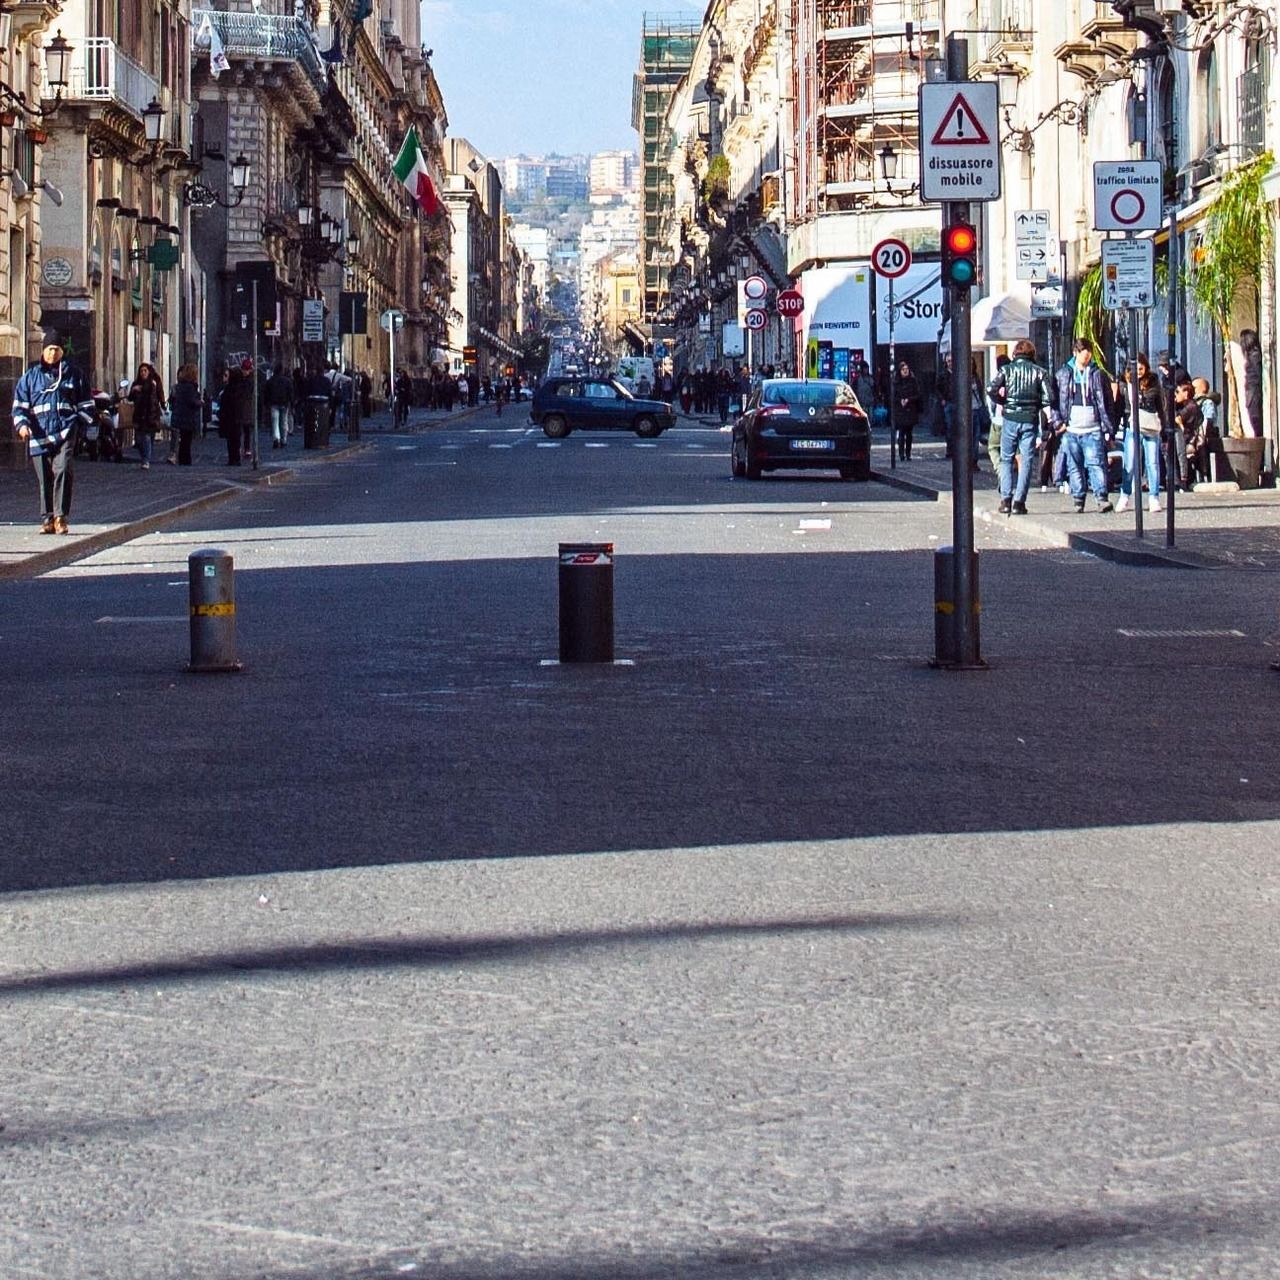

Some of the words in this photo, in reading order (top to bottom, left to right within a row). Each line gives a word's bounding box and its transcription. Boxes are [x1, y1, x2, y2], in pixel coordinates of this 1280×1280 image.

[929, 156, 993, 169] dissuasore
[941, 172, 983, 186] mobile
[1097, 176, 1126, 185] traffico
[1127, 175, 1159, 184] limitato
[881, 249, 904, 268] 20
[778, 298, 803, 310] STOP
[903, 299, 943, 319] Stor
[750, 314, 762, 326] 20
